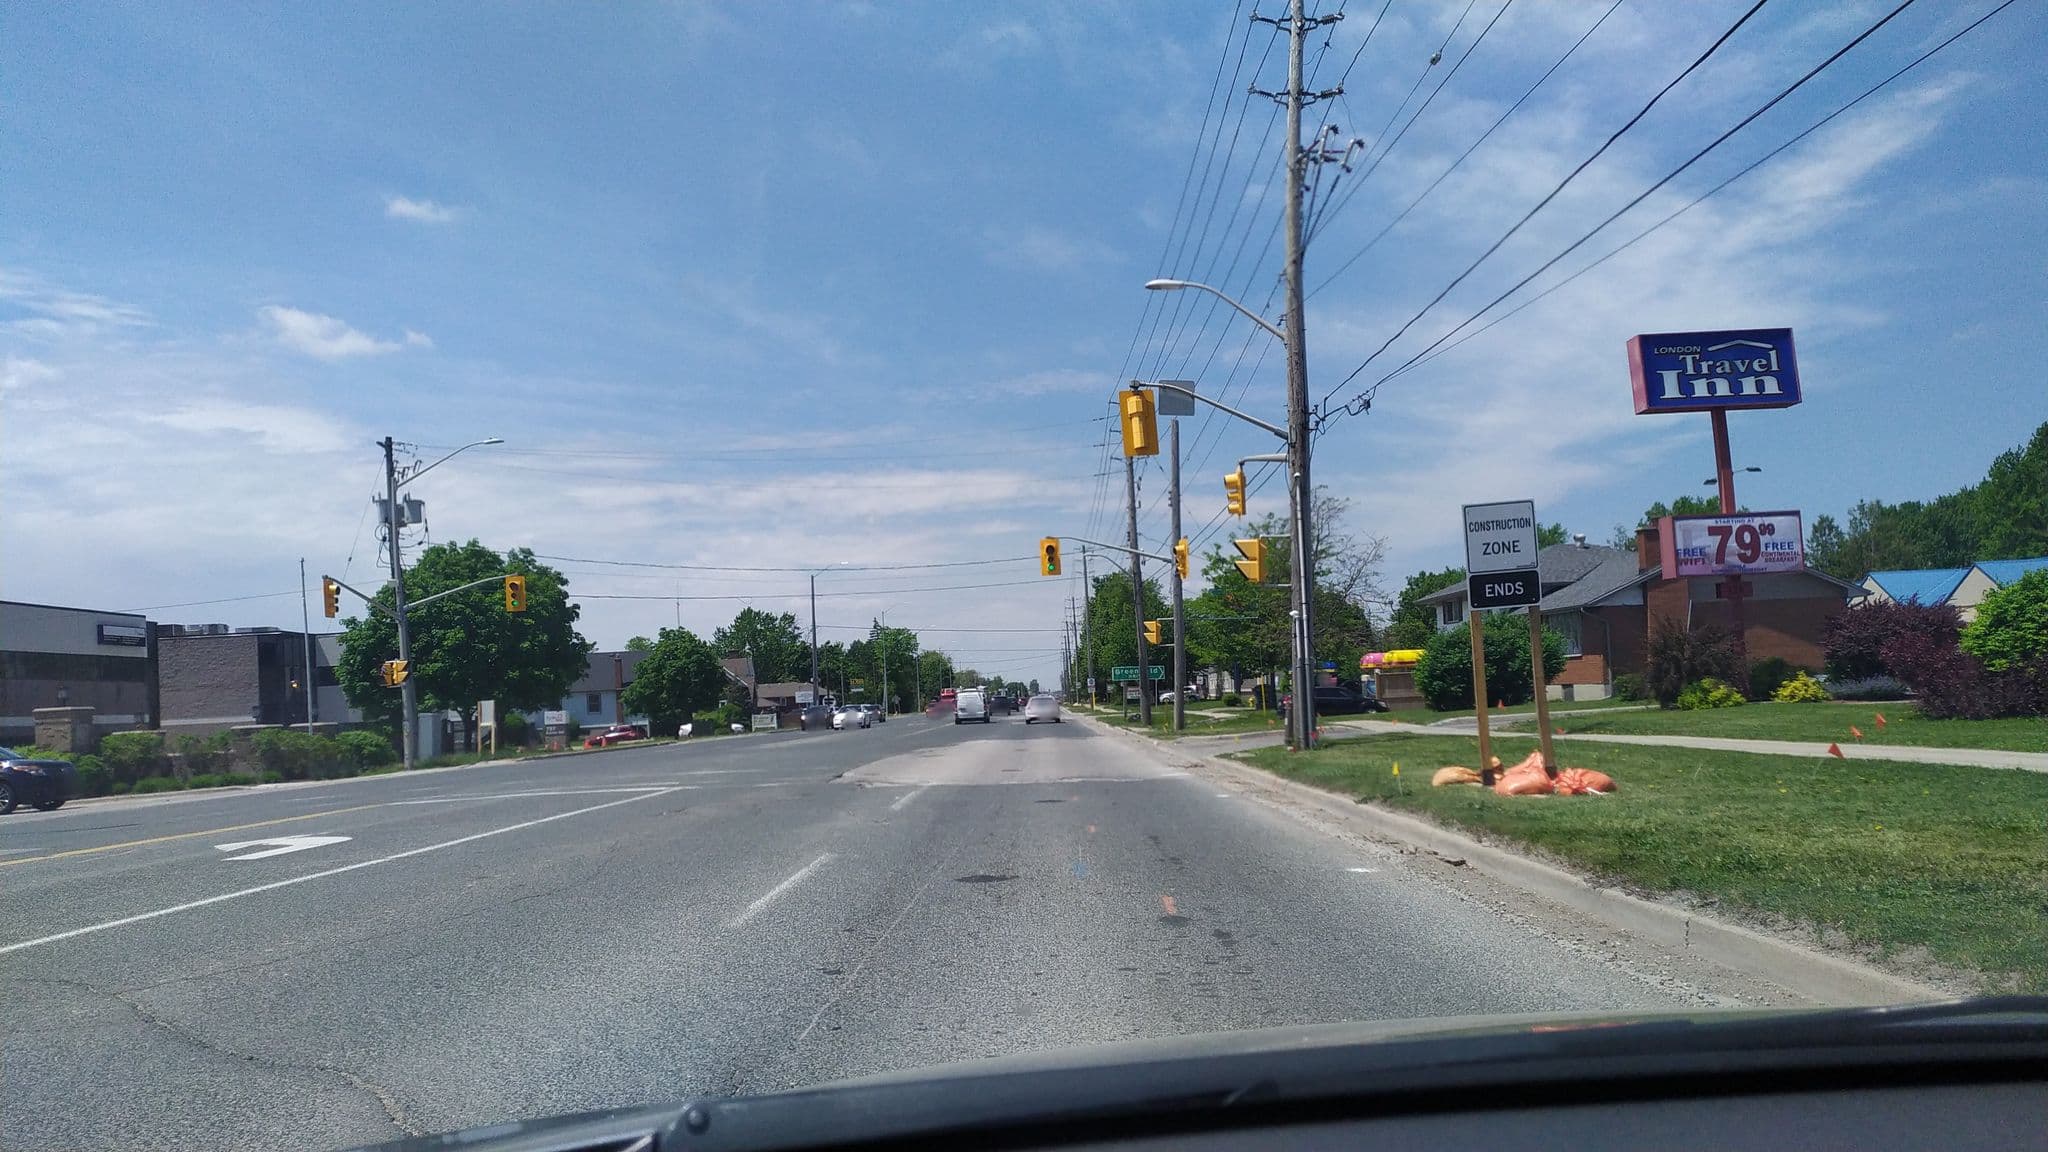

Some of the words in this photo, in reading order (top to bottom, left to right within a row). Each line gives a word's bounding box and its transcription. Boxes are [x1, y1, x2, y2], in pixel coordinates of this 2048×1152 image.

[1654, 345, 1701, 355] LONDON
[1679, 349, 1780, 375] Travel
[1656, 369, 1783, 399] Inn
[1469, 518, 1531, 532] CONSTRUCTION
[1482, 540, 1521, 556] ZONE
[1676, 547, 1707, 558] FREE
[1764, 541, 1794, 551] FREE
[1485, 582, 1524, 597] ENDS
[1114, 667, 1159, 675] Greenld
